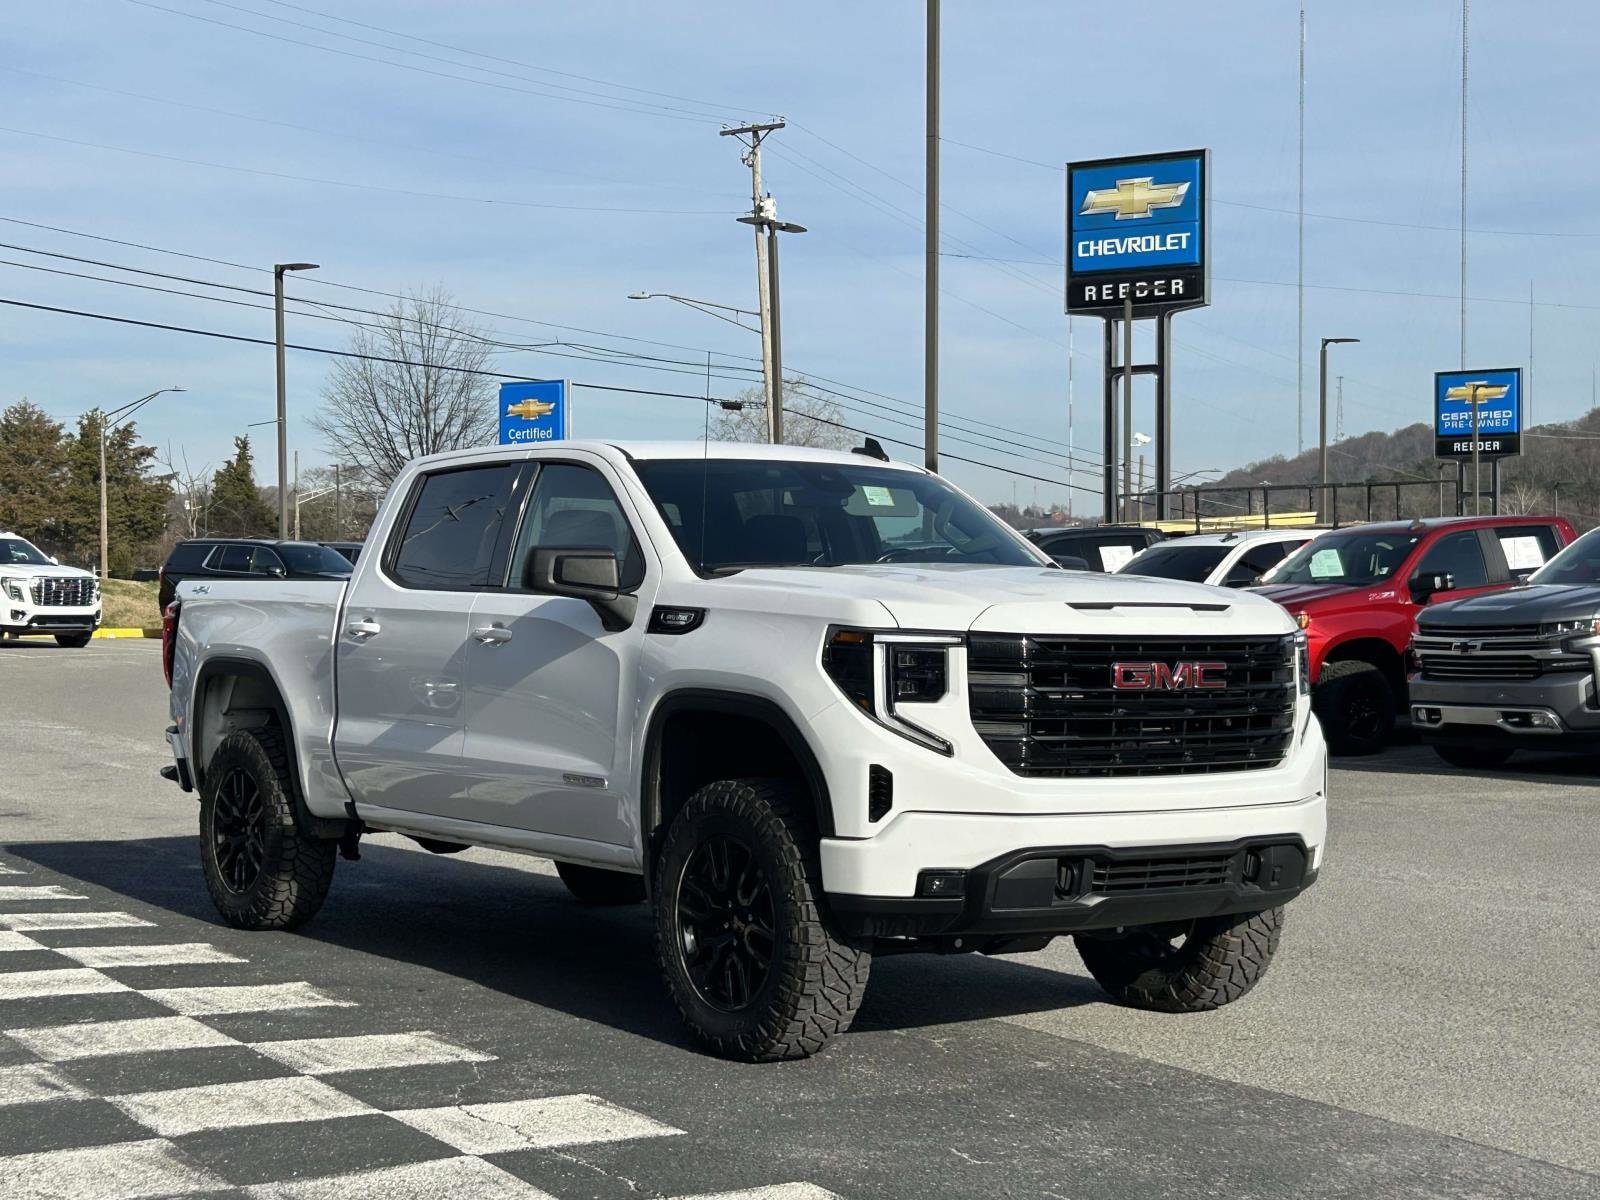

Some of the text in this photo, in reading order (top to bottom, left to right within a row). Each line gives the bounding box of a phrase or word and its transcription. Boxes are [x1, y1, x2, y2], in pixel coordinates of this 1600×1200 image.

[1078, 232, 1191, 257] CHEVROLET
[1085, 279, 1184, 301] REEDER
[508, 427, 553, 440] Certified
[1111, 661, 1227, 690] GMC
